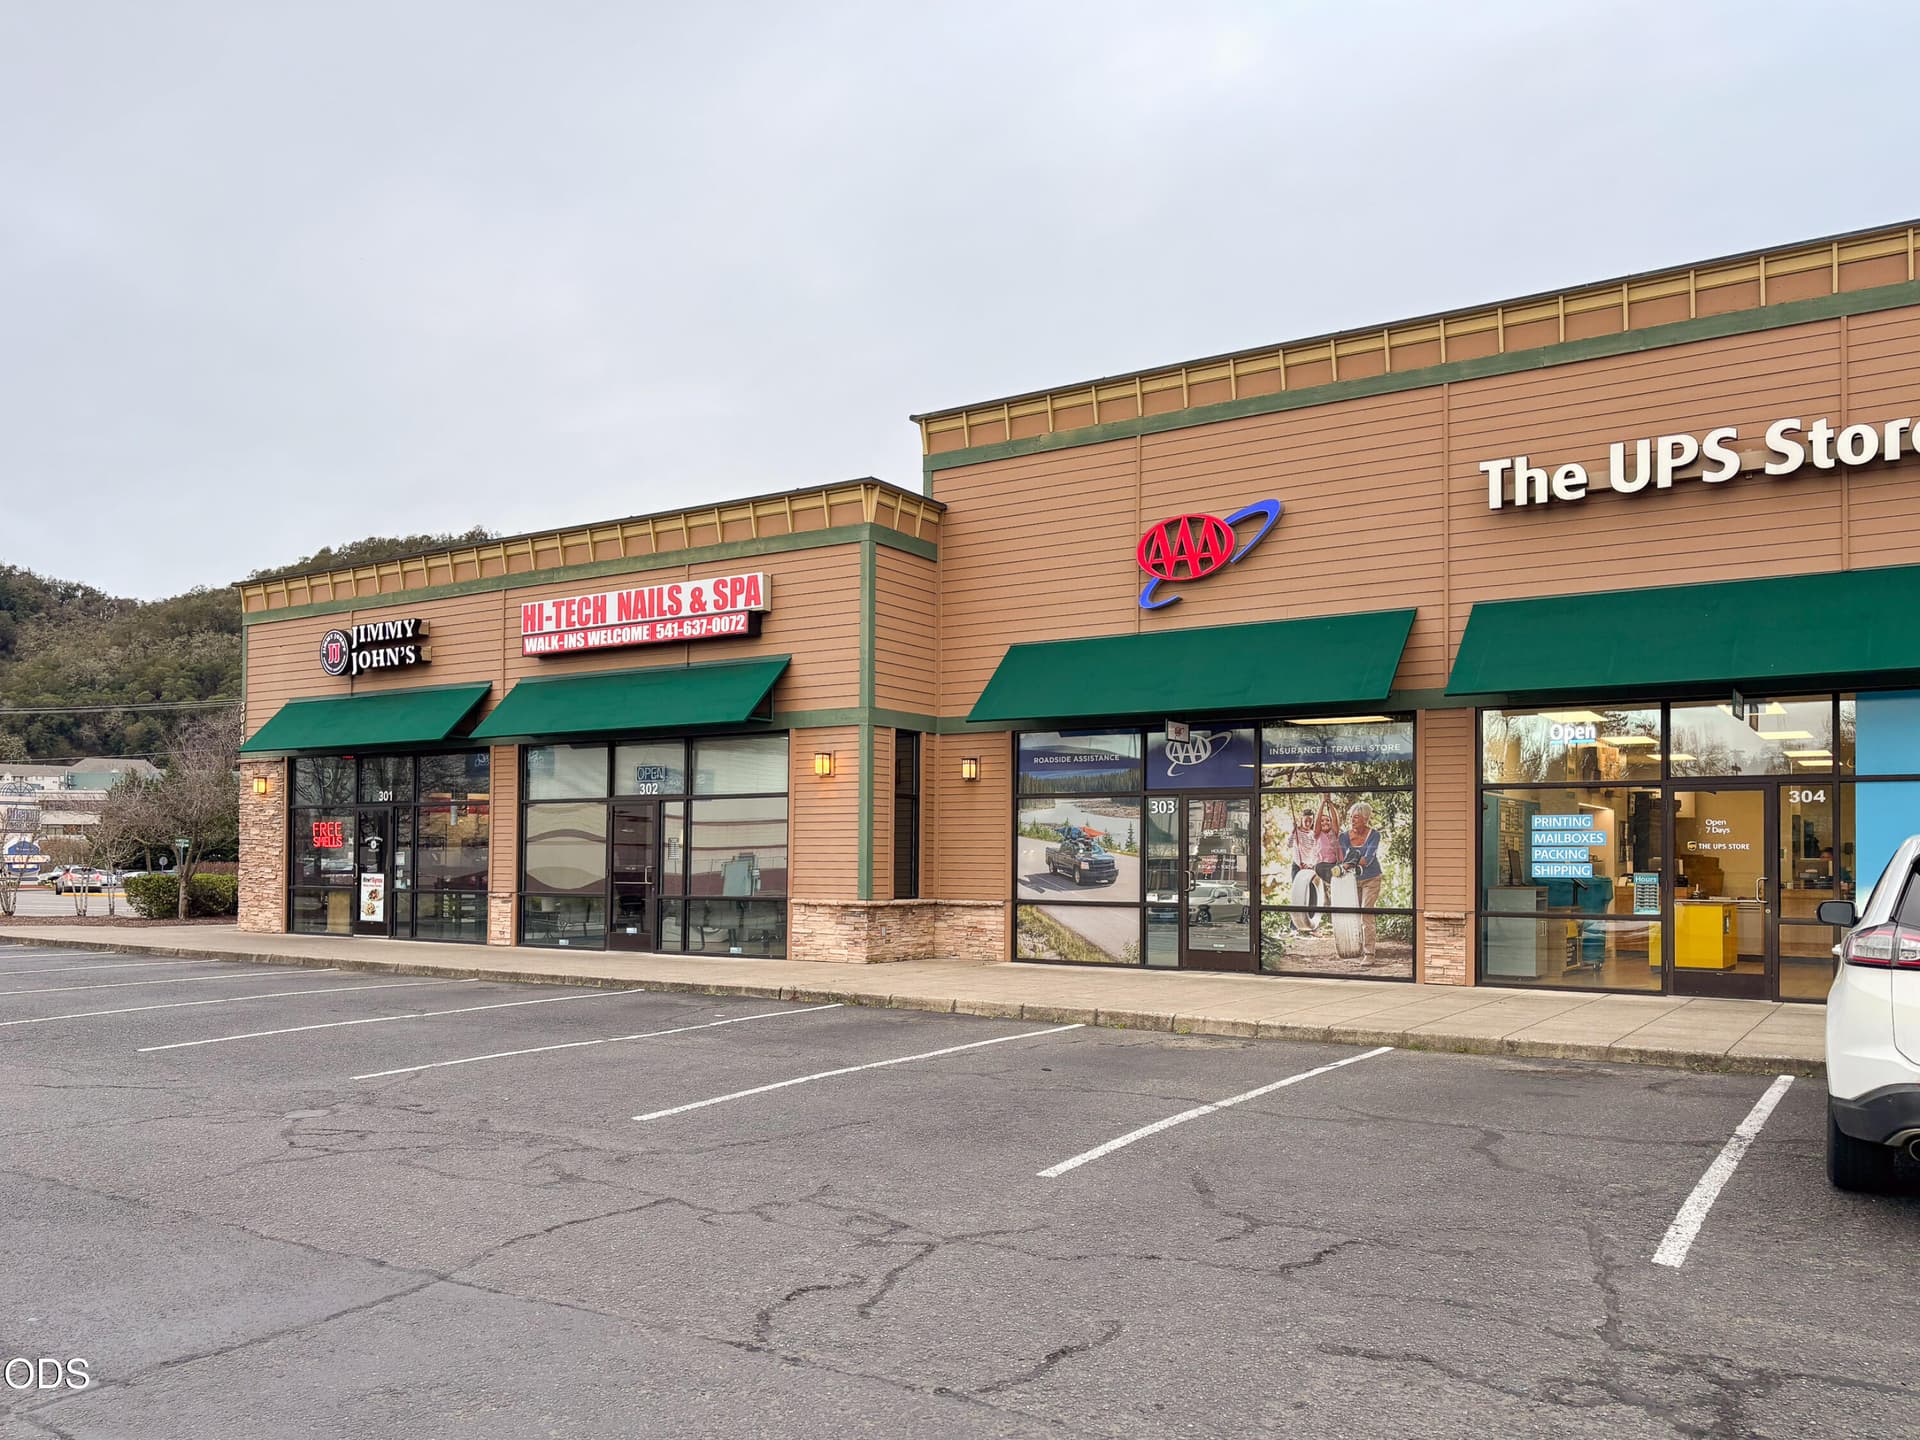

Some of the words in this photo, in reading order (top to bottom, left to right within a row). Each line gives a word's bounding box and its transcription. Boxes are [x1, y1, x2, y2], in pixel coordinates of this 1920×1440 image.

[1479, 455, 1588, 509] The
[1610, 427, 1741, 493] UPS
[1764, 418, 1920, 476] Stor
[1141, 514, 1230, 580] AAA
[522, 594, 607, 633] HI-TECH
[617, 585, 682, 621] NAILS
[690, 587, 707, 613] &
[713, 575, 762, 610] SPA
[351, 619, 415, 649] JIMMY
[525, 632, 585, 653] WALK-INS
[584, 625, 650, 646] WELCOME
[656, 615, 745, 639] 541-637-0072
[351, 645, 416, 675] JOHN'S
[1550, 724, 1596, 744] Open
[1169, 737, 1209, 765] AAA
[1269, 746, 1322, 756] INSURANCE
[1331, 744, 1367, 753] TRAVEL
[1368, 743, 1401, 752] STORE
[1033, 755, 1072, 764] ROADSIDE
[1073, 754, 1120, 763] ASSISTANCE
[637, 767, 666, 780] OPEN
[378, 790, 393, 801] 301
[639, 783, 658, 795] 302
[1788, 790, 1826, 803] 304
[1151, 801, 1175, 814] 303
[1534, 816, 1592, 827] PRINTING
[1705, 819, 1727, 827] Open
[312, 821, 343, 837] FREE
[1712, 827, 1731, 835] Days
[1534, 832, 1604, 843] MAILBOXES
[1534, 848, 1588, 860] PACKING
[1534, 864, 1591, 876] SHIPPING
